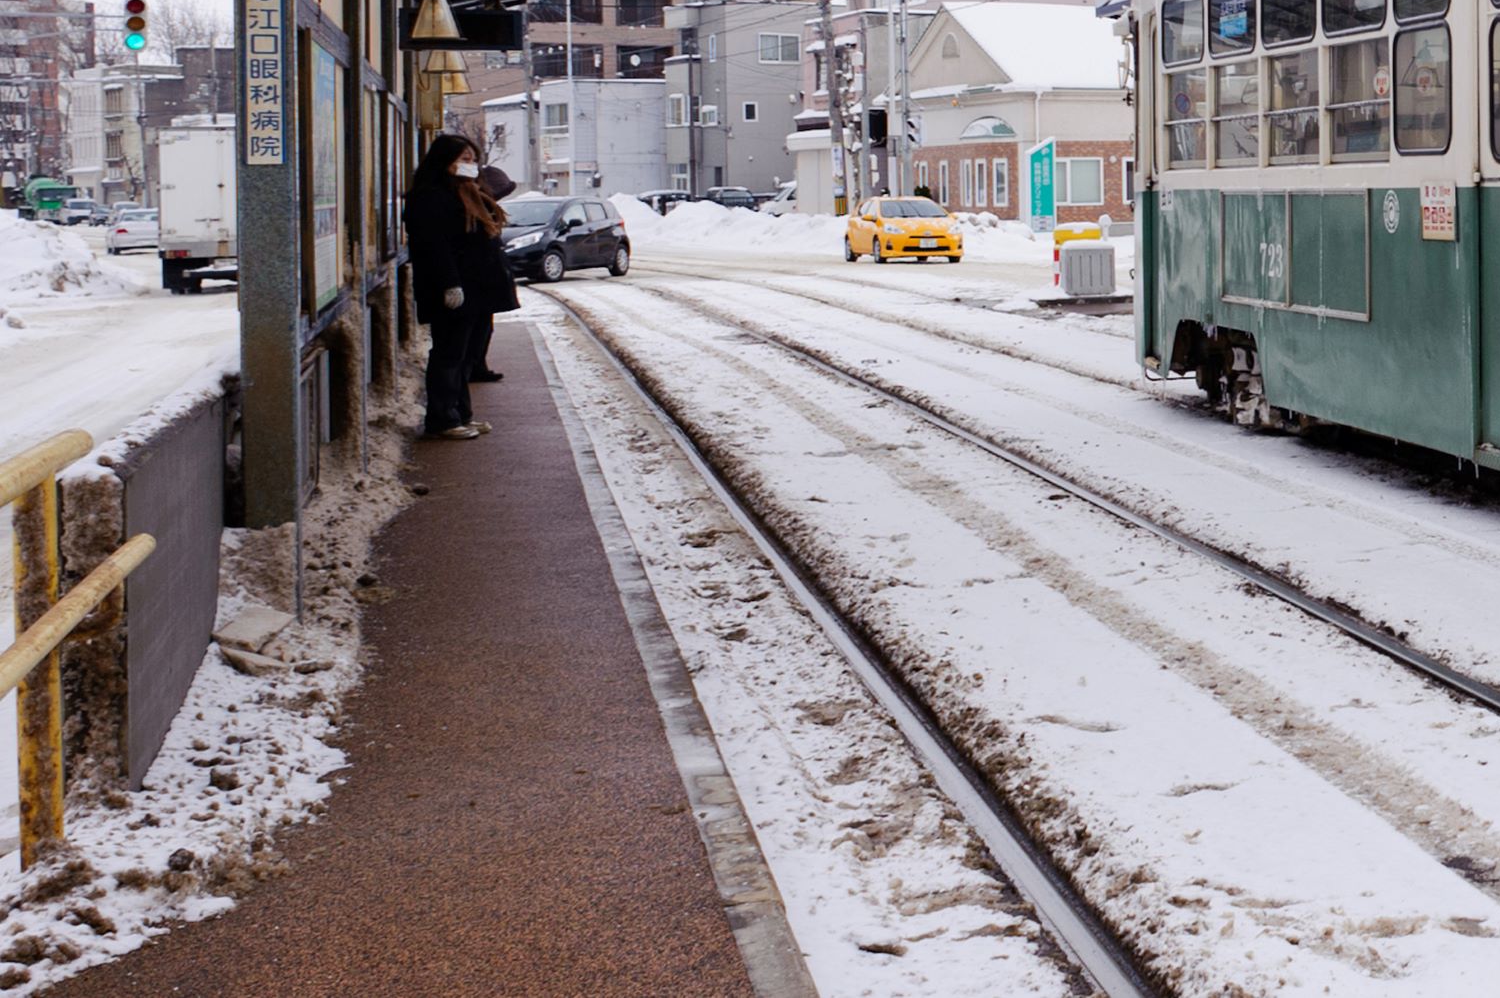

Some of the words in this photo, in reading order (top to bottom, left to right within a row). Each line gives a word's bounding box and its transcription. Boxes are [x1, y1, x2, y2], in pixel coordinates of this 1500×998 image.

[248, 7, 281, 158] 江口眼科病院
[1259, 242, 1284, 279] 723
